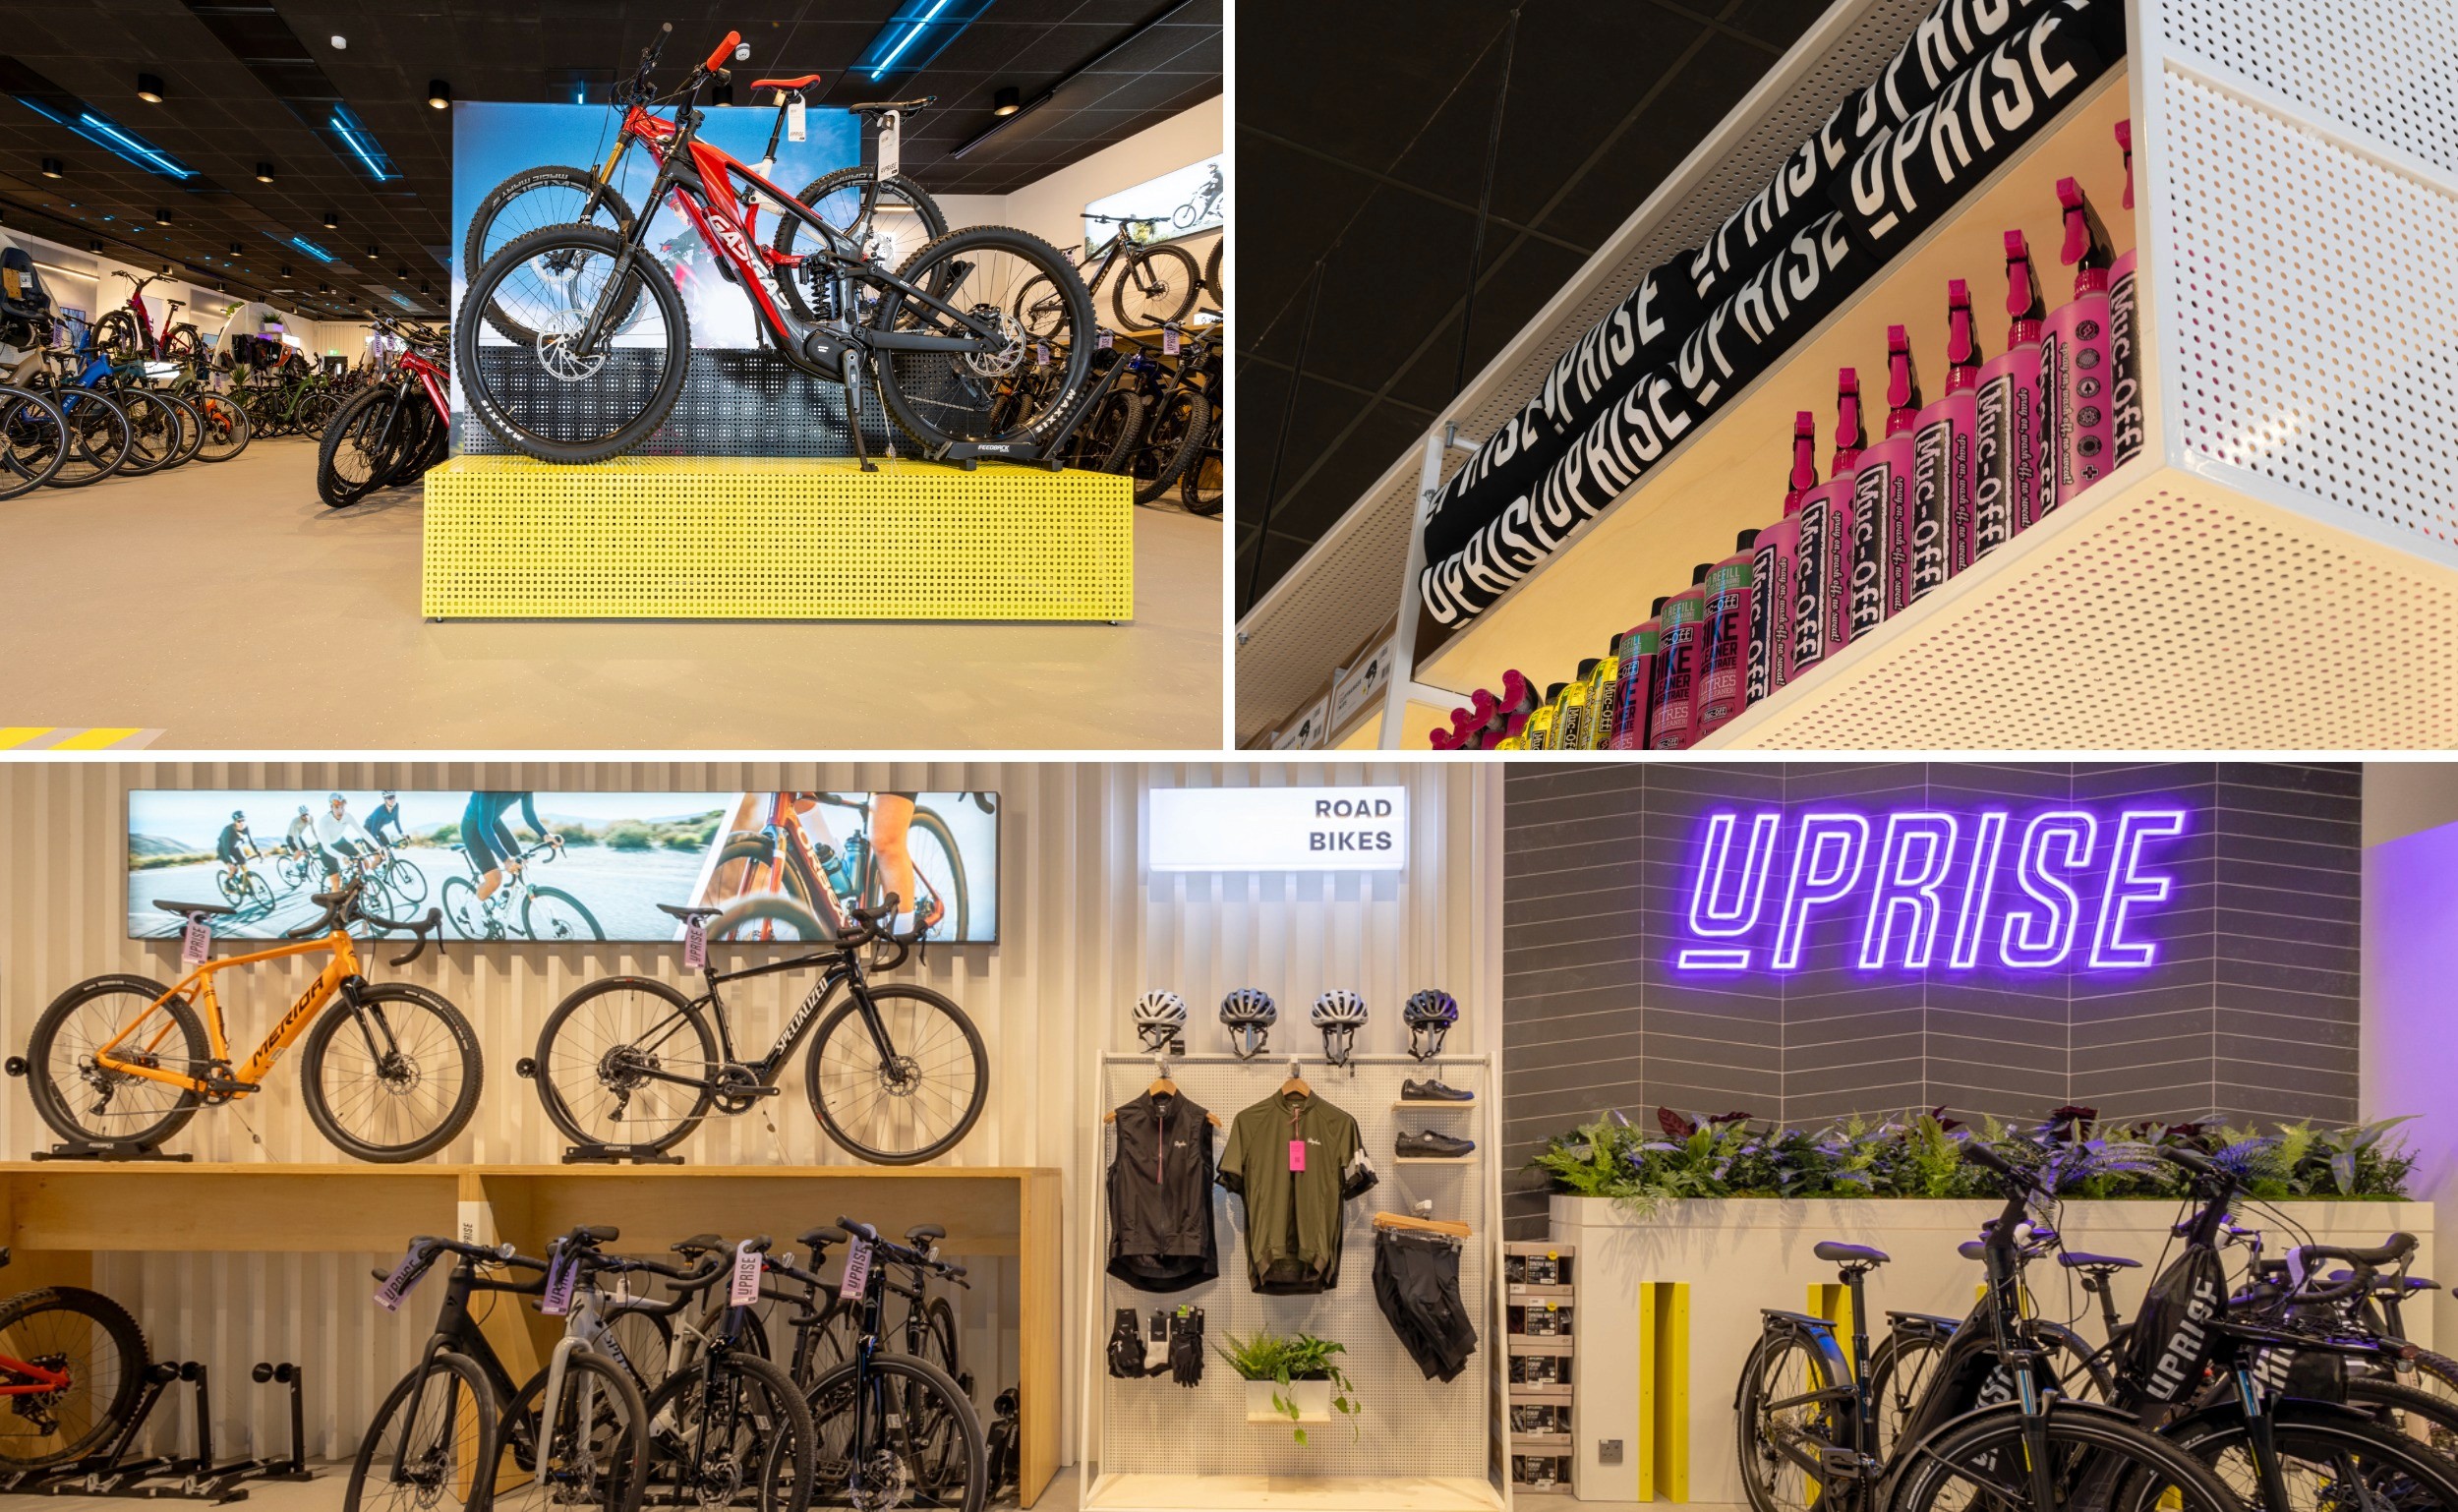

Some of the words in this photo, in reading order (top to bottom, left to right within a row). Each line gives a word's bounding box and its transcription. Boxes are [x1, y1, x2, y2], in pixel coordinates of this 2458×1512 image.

[1850, 10, 2078, 240] UPRISE
[501, 177, 531, 199] MARY
[708, 214, 791, 311] GASGAS
[1679, 210, 1849, 407] UPRISE
[1166, 330, 1179, 351] UPRISE
[2059, 343, 2071, 373] spray
[2111, 283, 2143, 454] Muc-Off
[1035, 388, 1077, 434] MAXXIS
[2017, 388, 2030, 417] spray
[2061, 390, 2074, 417] wash
[480, 399, 525, 442] MAXXIS
[1543, 360, 1692, 537] UPRISE
[1956, 434, 1968, 462] spray
[2019, 434, 2033, 461] wash
[2061, 437, 2071, 451] no
[1976, 387, 2006, 550] Muc-Off
[1894, 477, 1905, 504] spray
[1958, 479, 1971, 505] wash
[2020, 482, 2029, 497] no
[1831, 511, 1843, 538] spray
[1913, 432, 1944, 590] Muc-Off
[1895, 521, 1907, 547] wash
[1958, 526, 1967, 539] no
[1853, 475, 1881, 623] Muc-Off
[1712, 567, 1740, 582] REFILL
[1778, 557, 1788, 584] spray
[1833, 553, 1844, 579] wash
[1895, 566, 1903, 580] no
[1795, 510, 1819, 663] Muc-Off
[1668, 602, 1695, 617] REFILL
[1779, 600, 1789, 624] wash
[1832, 599, 1841, 611] no
[1746, 556, 1768, 703] Muc-Off
[1777, 643, 1785, 656] no
[1701, 675, 1736, 697] LITRES
[1602, 682, 1616, 730] Muc-Off
[1654, 707, 1689, 727] LITRES
[1565, 709, 1580, 750] Muc-Of
[1316, 799, 1392, 818] ROAD
[1310, 832, 1392, 850] BIKES
[796, 827, 846, 927] ORBEA
[1677, 811, 2185, 968] UPRISE
[689, 930, 704, 961] UPRISE
[253, 975, 324, 1067] MERIDA
[775, 976, 829, 1055] SPECIALIZED
[463, 1223, 473, 1246] PRISE
[737, 1257, 756, 1296] UPRISE
[849, 1246, 869, 1290] UPRISE
